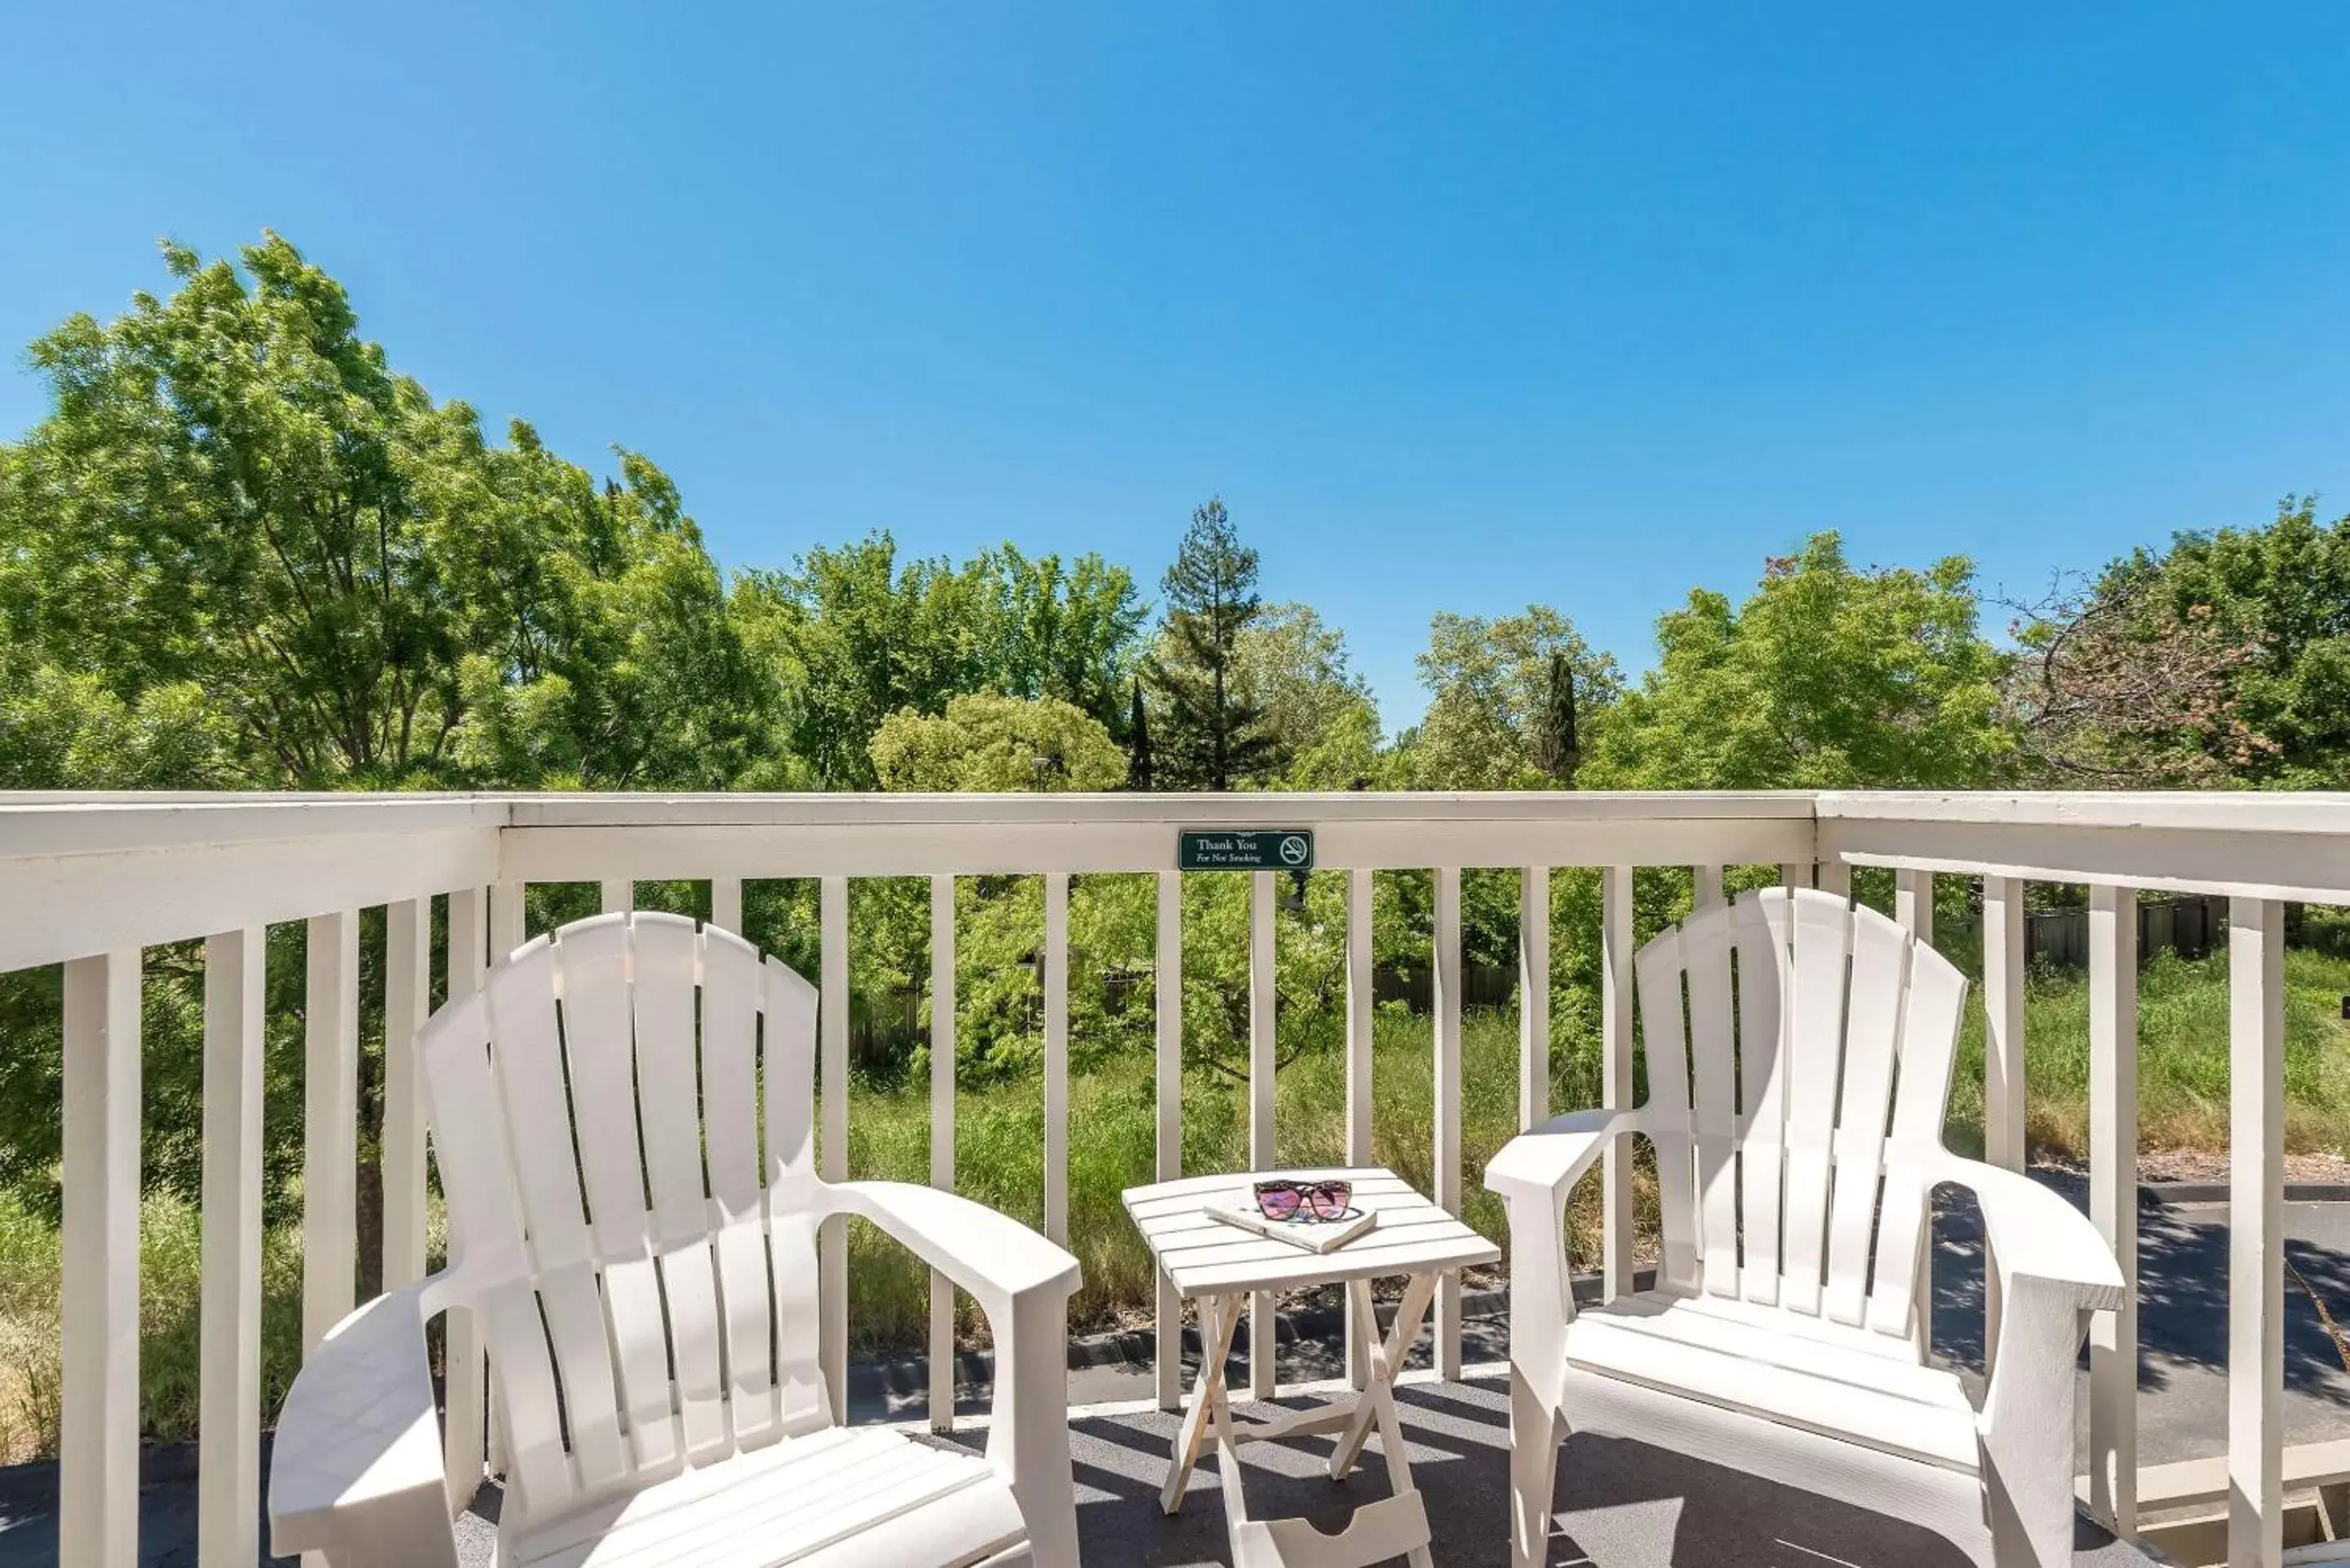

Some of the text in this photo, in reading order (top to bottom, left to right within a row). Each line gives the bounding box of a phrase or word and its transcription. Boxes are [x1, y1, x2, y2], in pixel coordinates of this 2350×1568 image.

[1196, 839, 1257, 850] Thank You
[1196, 853, 1261, 863] For Not Smoking
